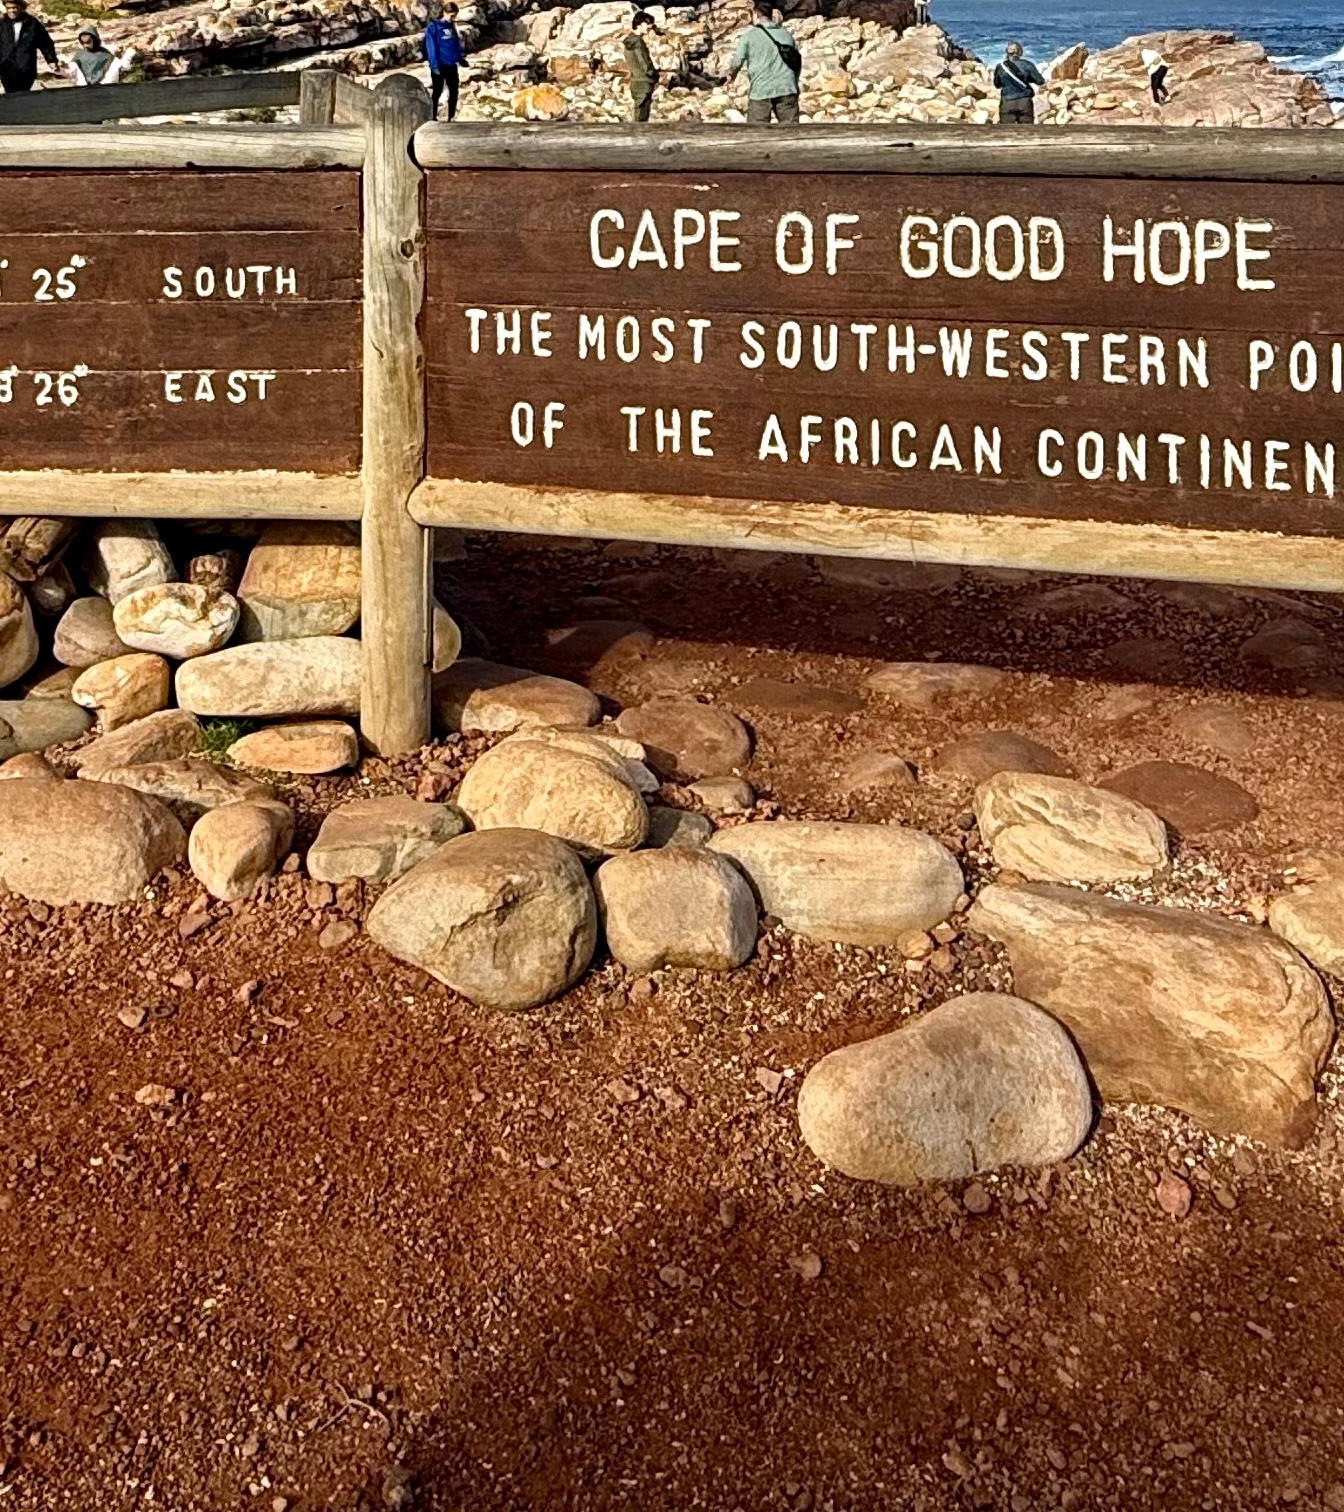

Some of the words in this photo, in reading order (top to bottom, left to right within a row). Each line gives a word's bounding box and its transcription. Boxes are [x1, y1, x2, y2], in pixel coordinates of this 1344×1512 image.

[162, 265, 298, 300] SOUTH
[589, 208, 742, 272] CAPE
[775, 210, 860, 276] OF
[899, 213, 1065, 281] GOOD
[1102, 214, 1276, 291] HOPE
[464, 308, 553, 358] THE
[578, 314, 712, 364] MOST
[739, 320, 1210, 388] SOUTH-WESTERN
[163, 369, 276, 404] EAST
[510, 401, 566, 449] OF
[620, 406, 714, 457] THE
[758, 414, 1002, 475] AFRICAN
